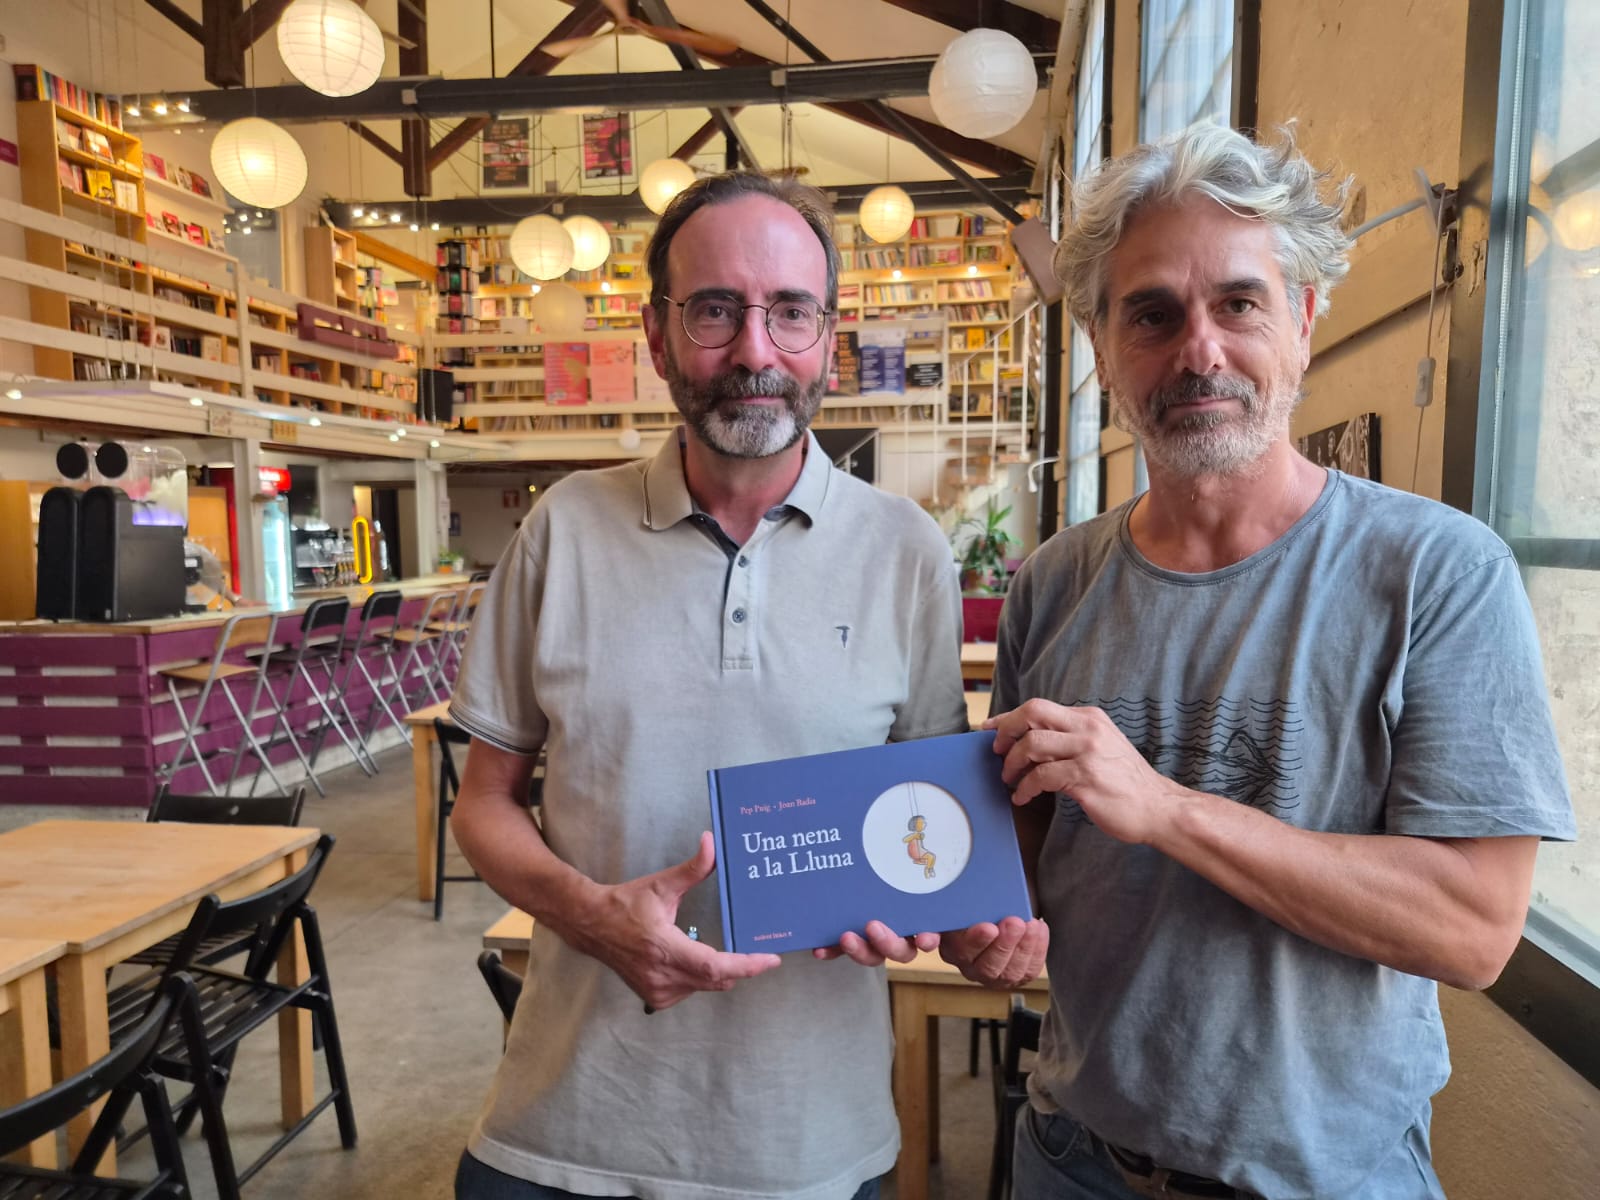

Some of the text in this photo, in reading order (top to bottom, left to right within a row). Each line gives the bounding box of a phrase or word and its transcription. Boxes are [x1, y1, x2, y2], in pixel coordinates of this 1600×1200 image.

[740, 798, 816, 815] Pep Puig Joan Badia
[741, 827, 841, 853] Una nena
[748, 850, 854, 879] a la Lluna
